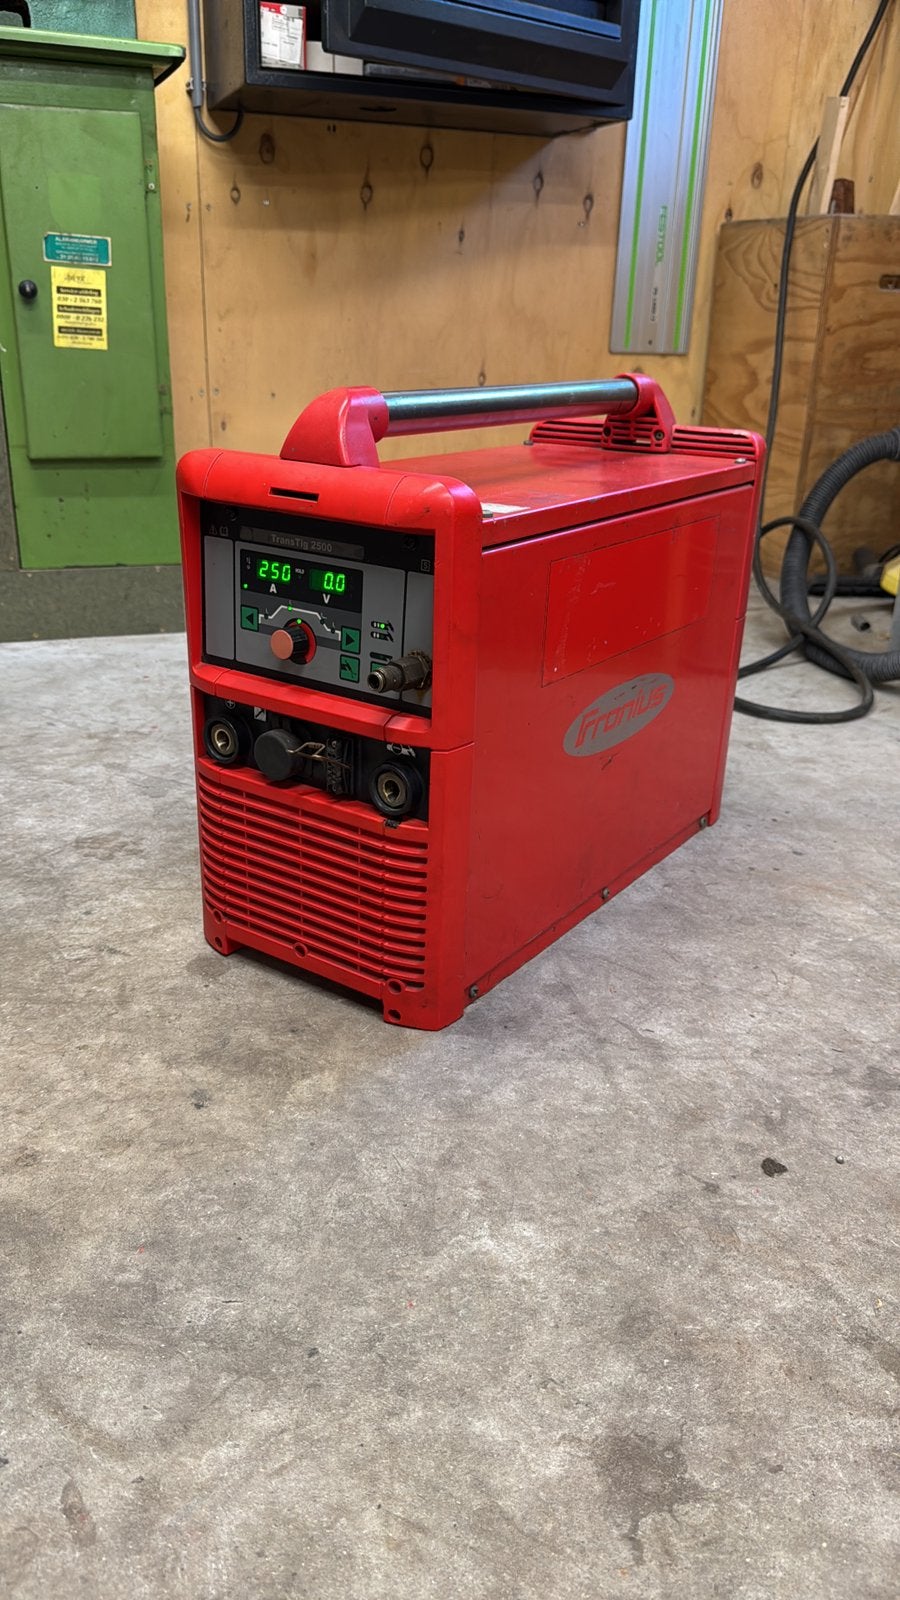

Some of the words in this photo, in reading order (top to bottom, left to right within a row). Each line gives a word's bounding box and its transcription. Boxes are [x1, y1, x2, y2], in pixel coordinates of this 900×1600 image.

[311, 540, 333, 552] 2500
[259, 560, 291, 581] 250
[269, 583, 277, 594] A
[324, 572, 345, 591] 0.0
[322, 593, 331, 604] V
[575, 683, 669, 749] Fronius
